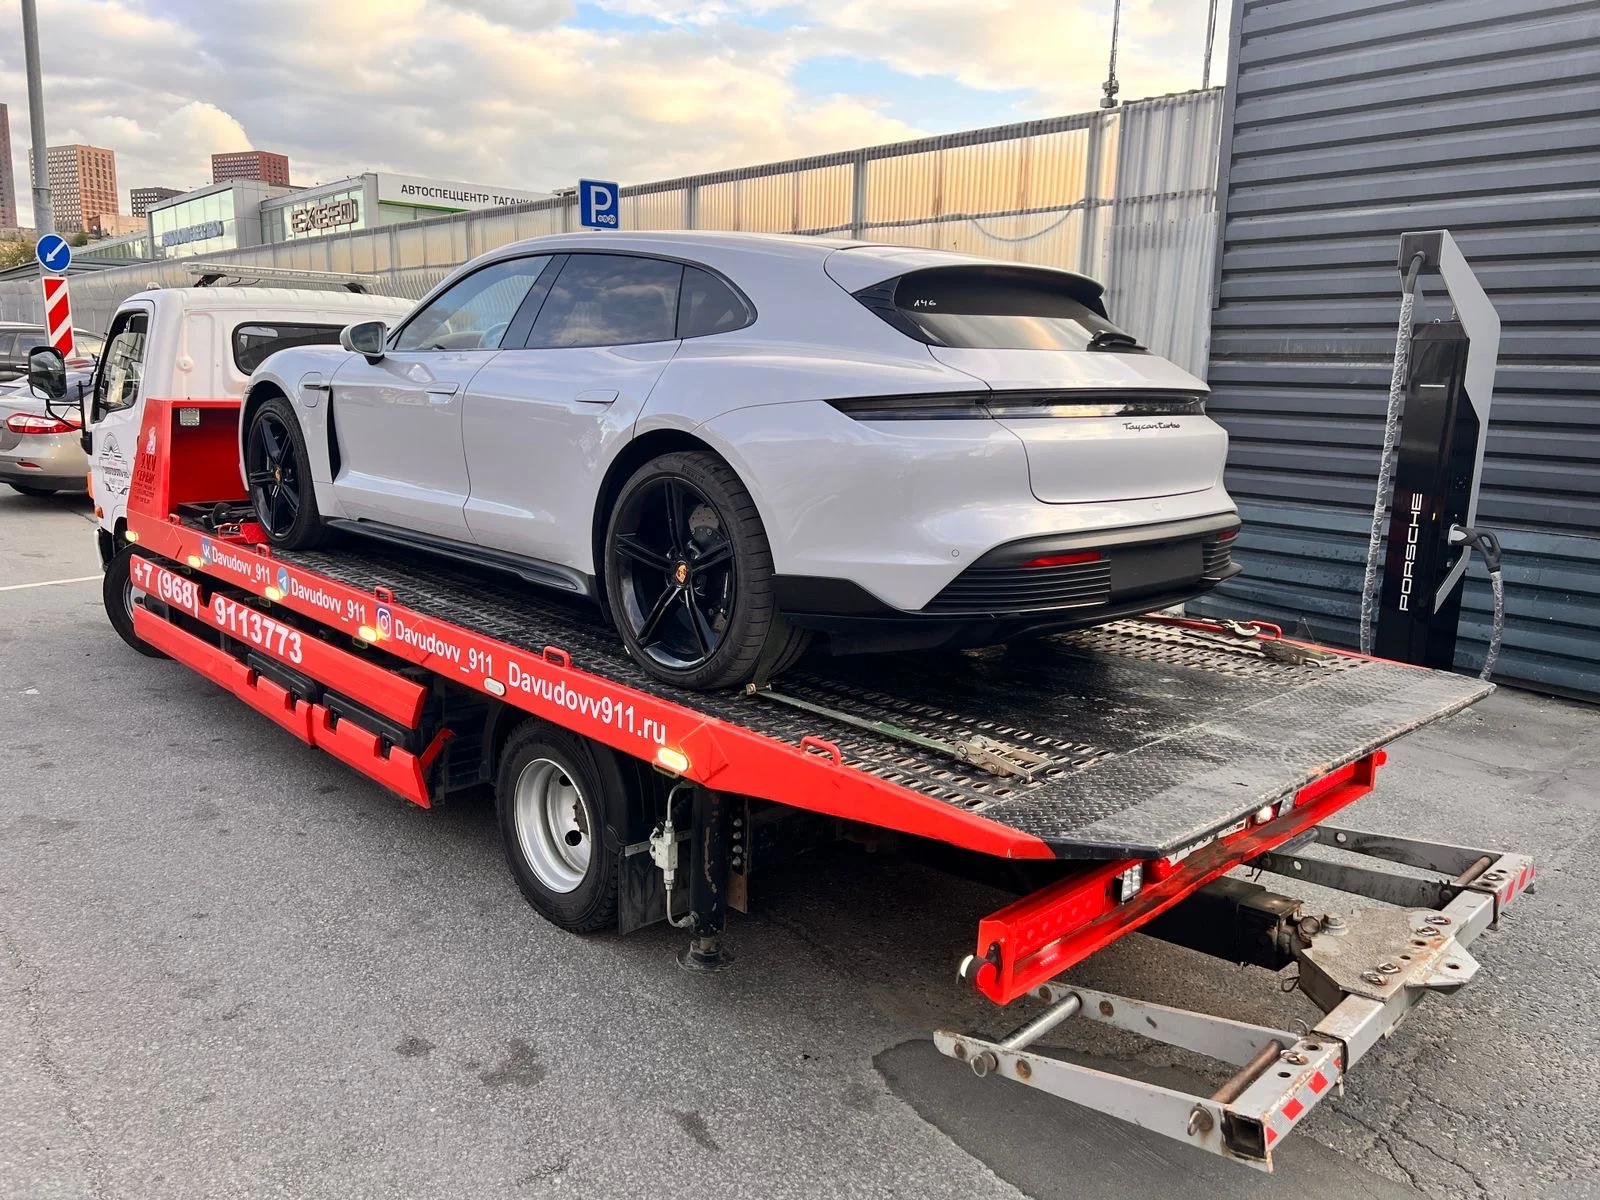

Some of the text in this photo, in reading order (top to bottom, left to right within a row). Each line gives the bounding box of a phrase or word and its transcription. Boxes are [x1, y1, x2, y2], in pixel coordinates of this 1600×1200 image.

[291, 199, 356, 233] EXEED
[401, 184, 533, 206] АВТОСПЕЦЦЕНТР ТАГАН
[590, 185, 612, 223] P
[1122, 422, 1157, 432] Taycan
[212, 545, 271, 585] Davudovv_911
[1399, 493, 1423, 612] PORSCHE
[134, 562, 153, 589] +7
[214, 596, 303, 664] 9113773
[291, 577, 366, 624] Davudovv_911
[395, 619, 493, 677] Davudovv_911
[508, 661, 667, 745] Davudovv911.ru
